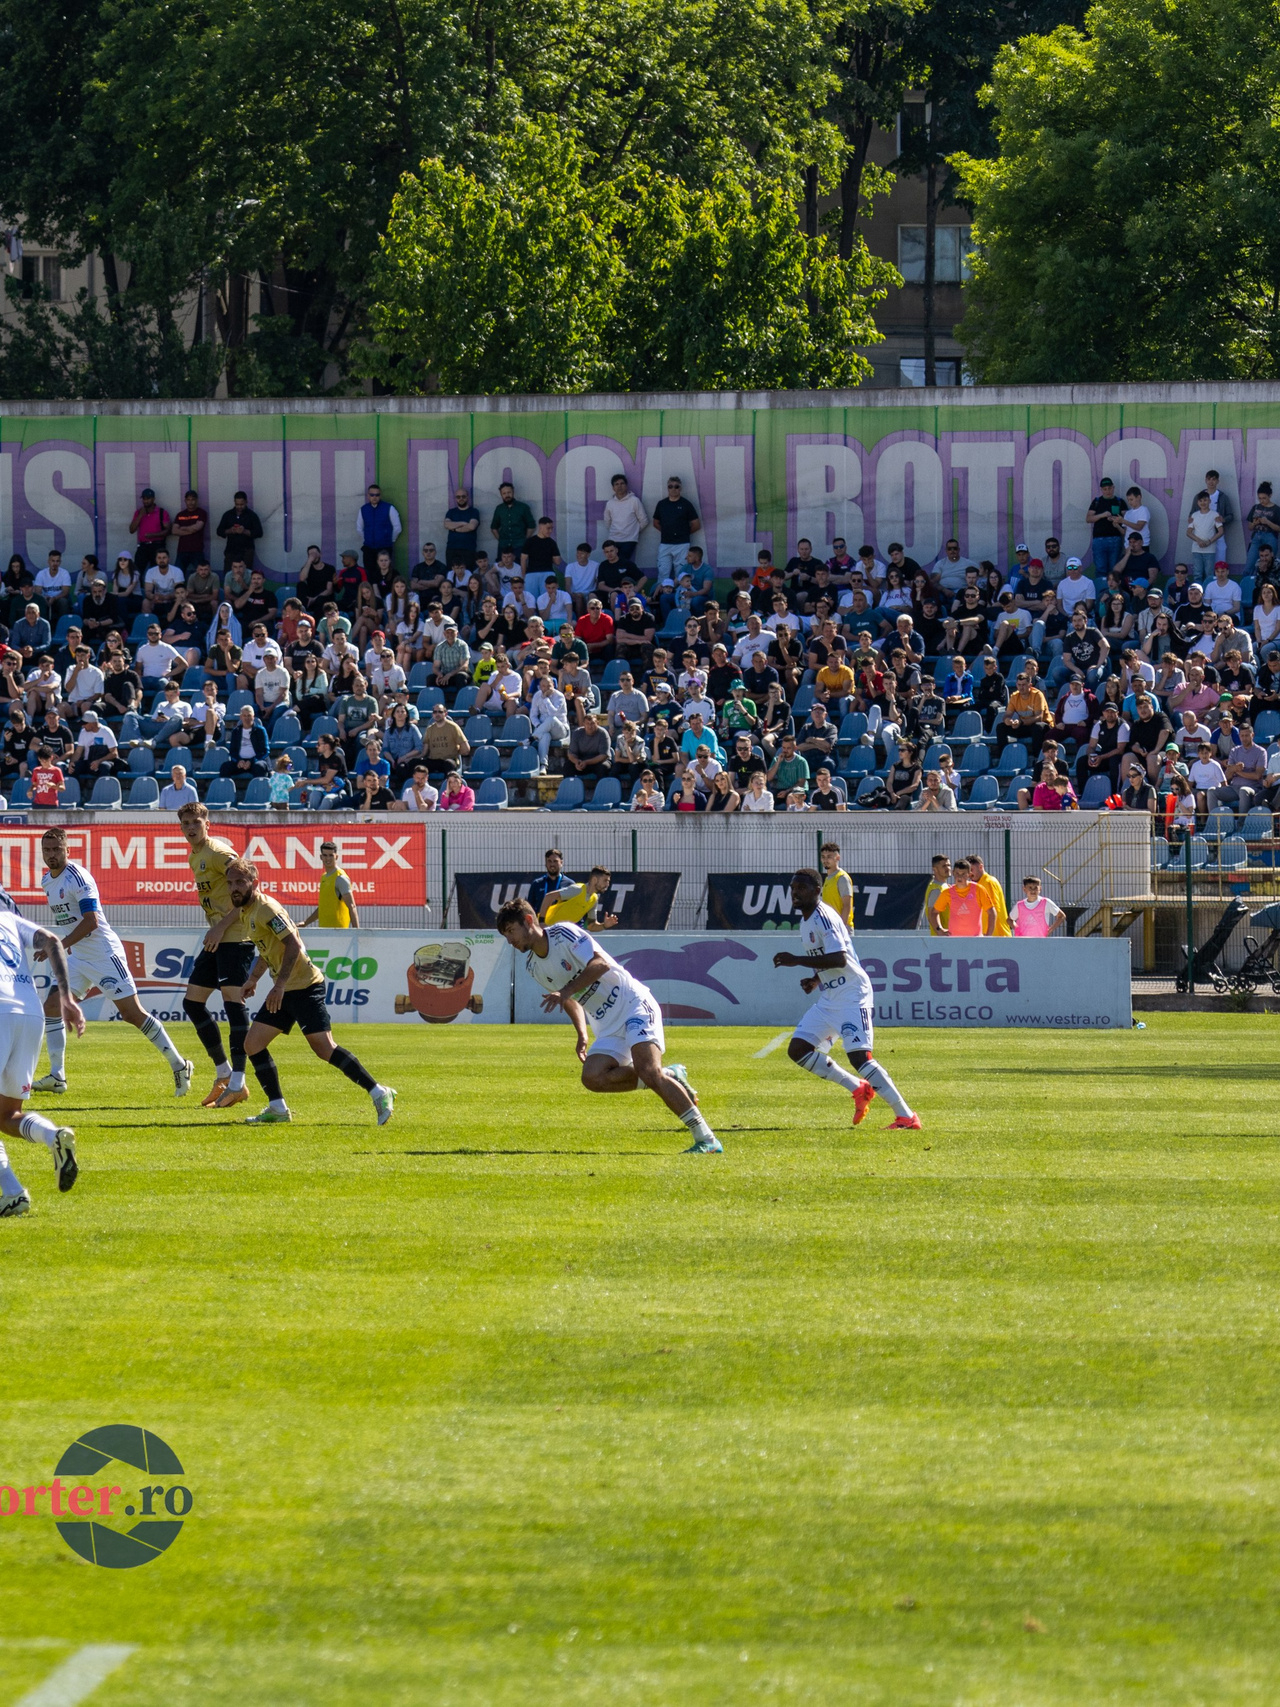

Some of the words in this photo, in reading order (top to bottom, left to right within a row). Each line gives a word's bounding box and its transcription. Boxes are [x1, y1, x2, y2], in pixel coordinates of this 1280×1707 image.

[100, 836, 414, 869] MEANEX
[306, 949, 379, 981] Eco
[860, 952, 1020, 993] estra
[324, 982, 371, 1006] lus
[911, 1001, 993, 1021] Elsaco
[1005, 1013, 1111, 1026] www.vestra.ro
